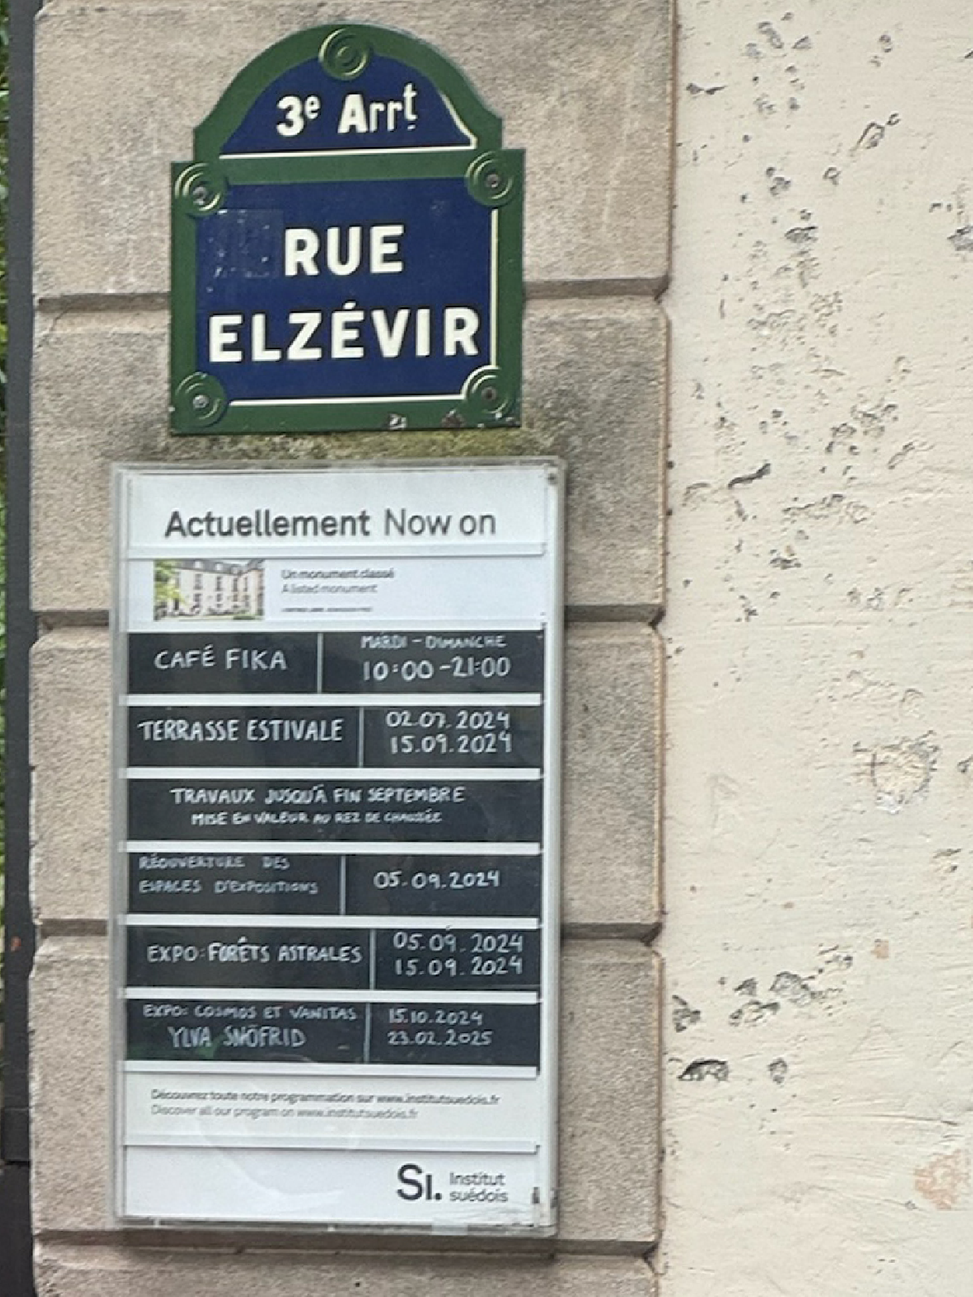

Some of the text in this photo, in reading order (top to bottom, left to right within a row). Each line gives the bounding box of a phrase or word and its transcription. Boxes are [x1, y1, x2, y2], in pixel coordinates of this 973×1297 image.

[276, 94, 321, 137] 3e
[283, 224, 405, 276] RUE
[208, 300, 480, 363] ELZÉVIR
[164, 508, 497, 538] Actuellement Now on
[298, 569, 359, 579] monument
[290, 583, 319, 594] listed
[320, 584, 378, 594] monument
[360, 635, 408, 649] MARDI
[425, 635, 507, 650] DIMANCHE
[154, 644, 287, 670] CAFÉ FIKA
[363, 660, 433, 681] 10:00
[137, 719, 343, 741] TERRASSE ESTIVALE
[169, 788, 255, 804] TRAVAUX
[333, 788, 362, 803] FIN
[367, 786, 466, 803] SEPTEMBRE
[191, 812, 227, 825] MISE
[231, 812, 252, 825] EN
[253, 812, 309, 825] VALEUR
[334, 812, 361, 823] REZ
[365, 812, 380, 823] DE
[139, 853, 290, 870] RÉOUVERTURE DES
[139, 879, 318, 894] ESPACES D'EXPOSITIONS
[278, 945, 363, 963] ASTRALES
[194, 1005, 257, 1019] COSMOS
[262, 1006, 283, 1019] ET
[289, 1006, 357, 1020] VANITAS
[388, 1008, 483, 1025] 15.10.2024
[167, 1026, 212, 1048] YLVA
[387, 1029, 493, 1046] 23.02.2025
[151, 1089, 209, 1100] Découvrez
[210, 1091, 238, 1100] toute
[241, 1092, 268, 1101] notre
[271, 1092, 354, 1104] programmation
[356, 1095, 374, 1103] sur
[151, 1104, 197, 1115] Discover
[214, 1108, 231, 1116] our
[449, 1171, 506, 1186] Institut
[449, 1188, 509, 1202] suédois
